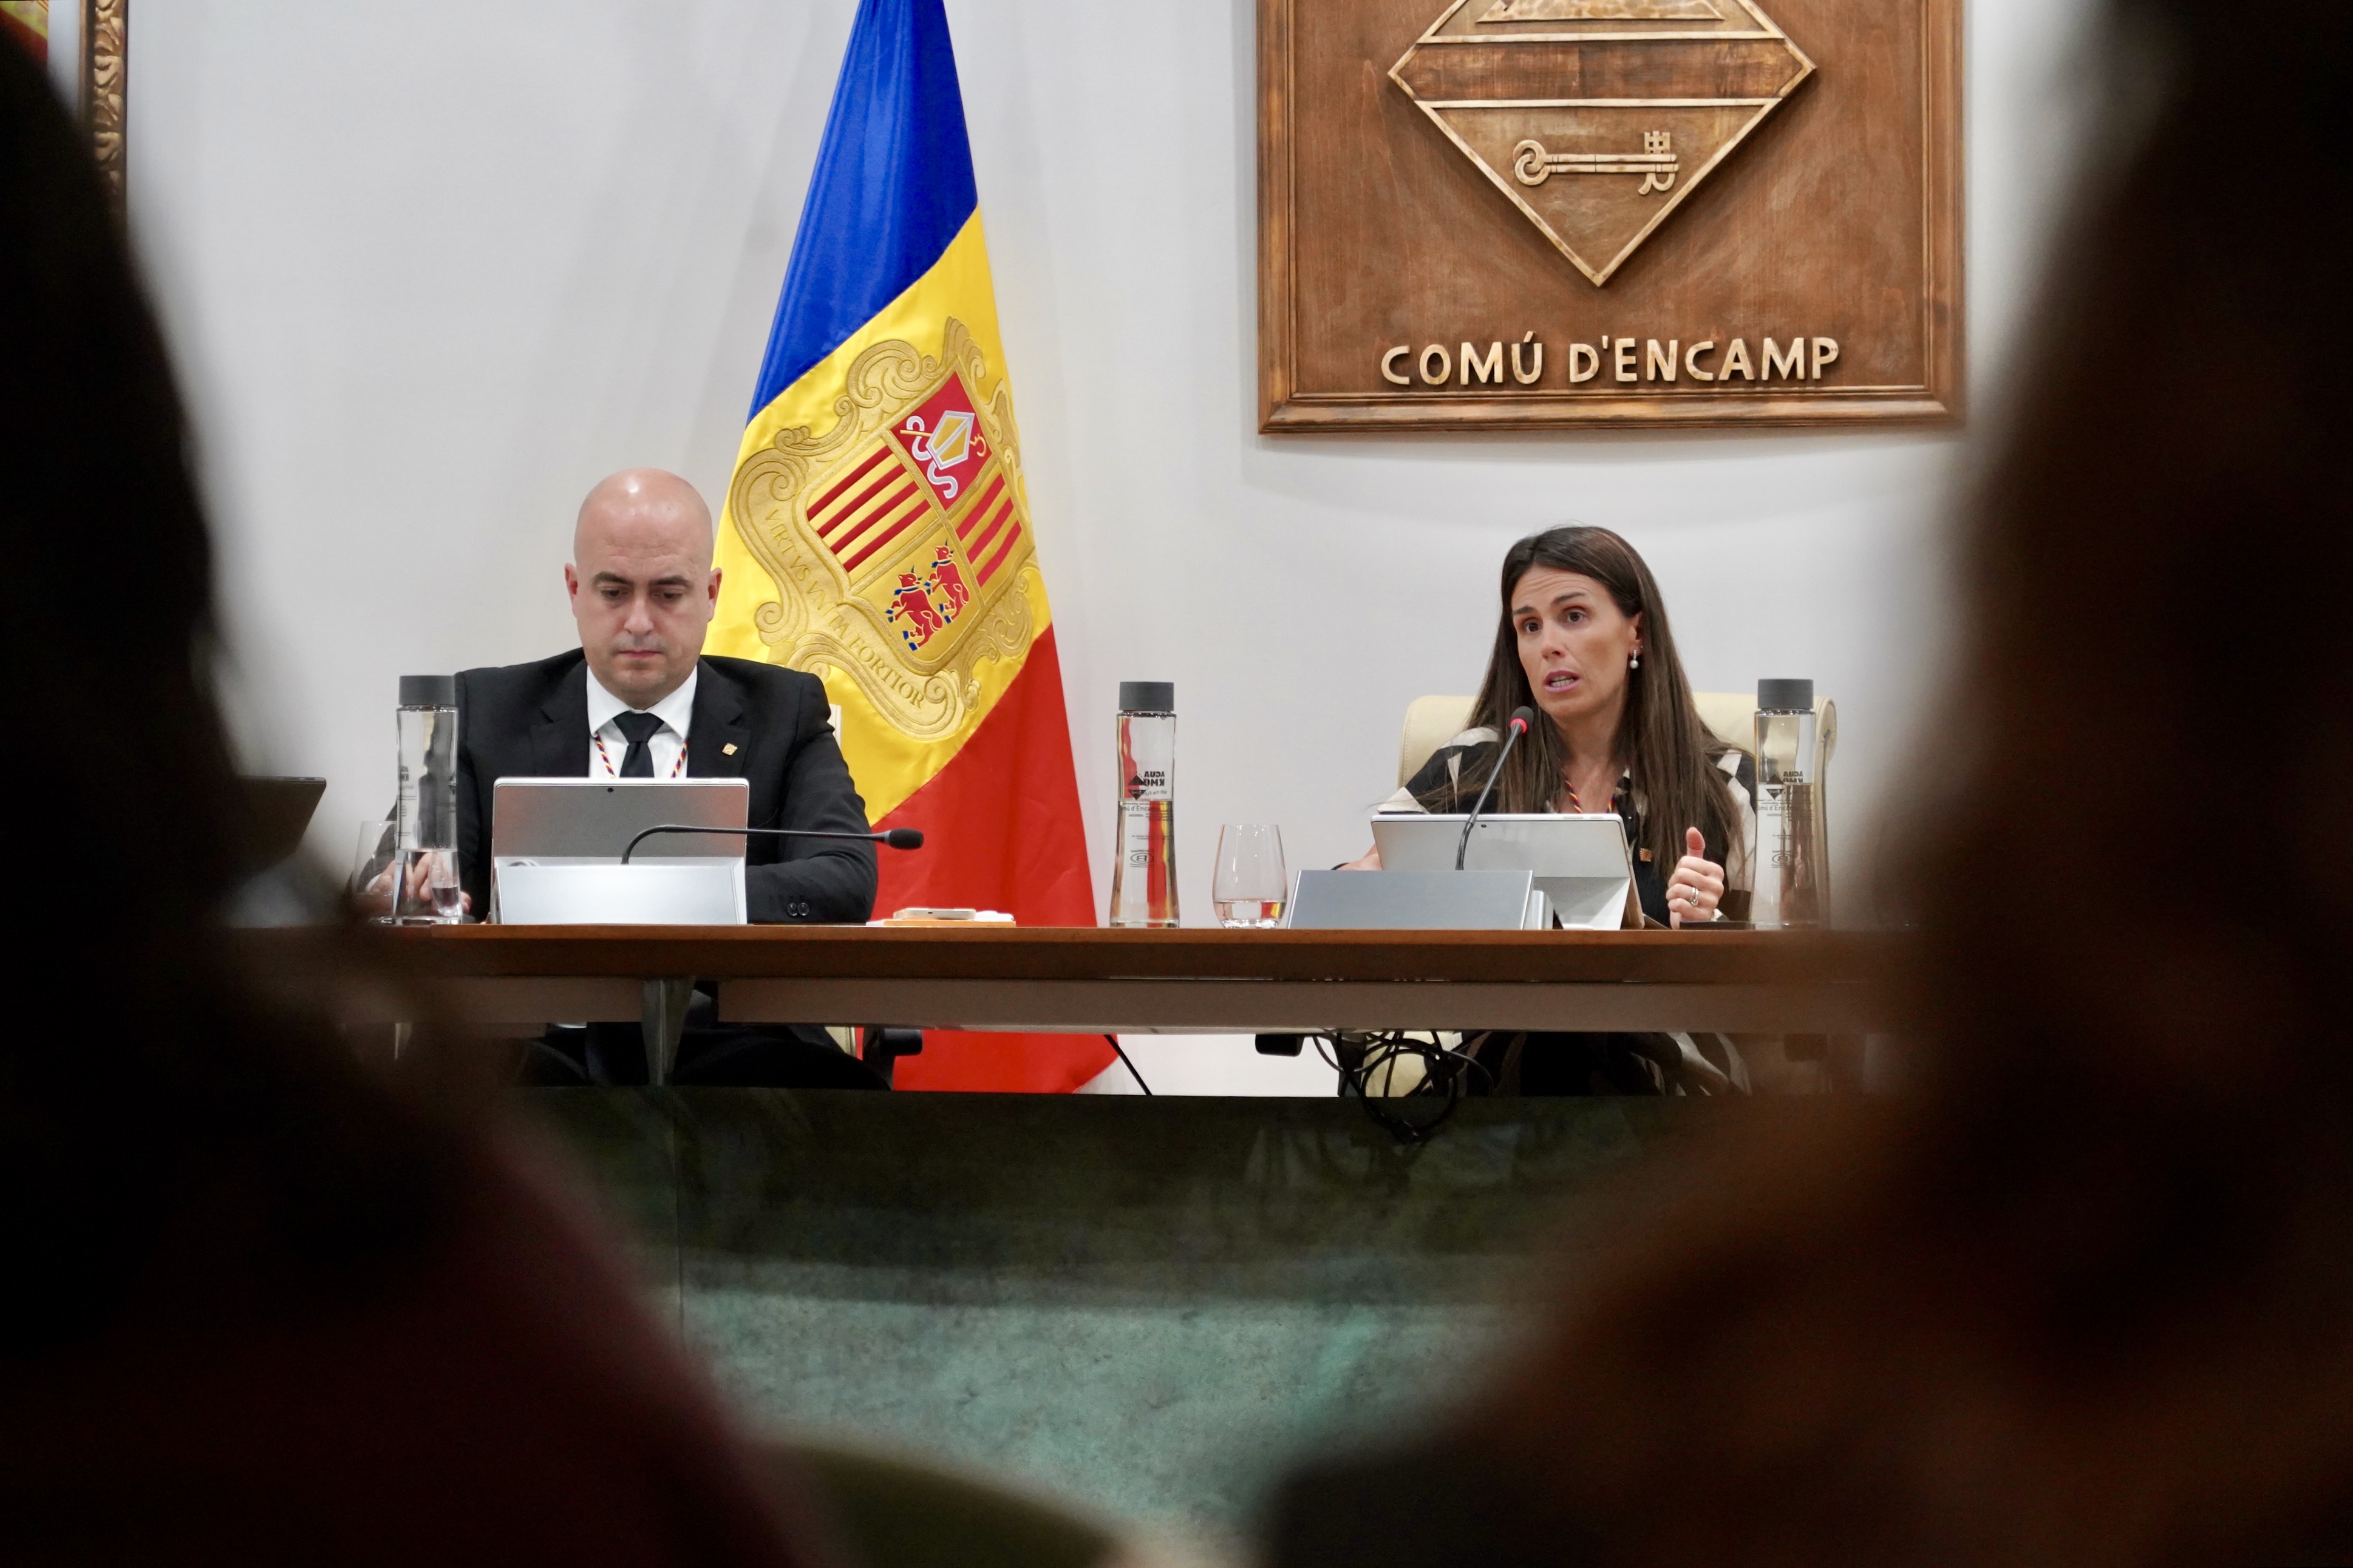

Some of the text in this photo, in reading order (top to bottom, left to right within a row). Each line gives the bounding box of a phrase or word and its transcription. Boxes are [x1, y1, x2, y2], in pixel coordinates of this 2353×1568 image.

[1381, 331, 1839, 385] COMÚ D'ENCAMP
[850, 637, 924, 709] FORTIOR
